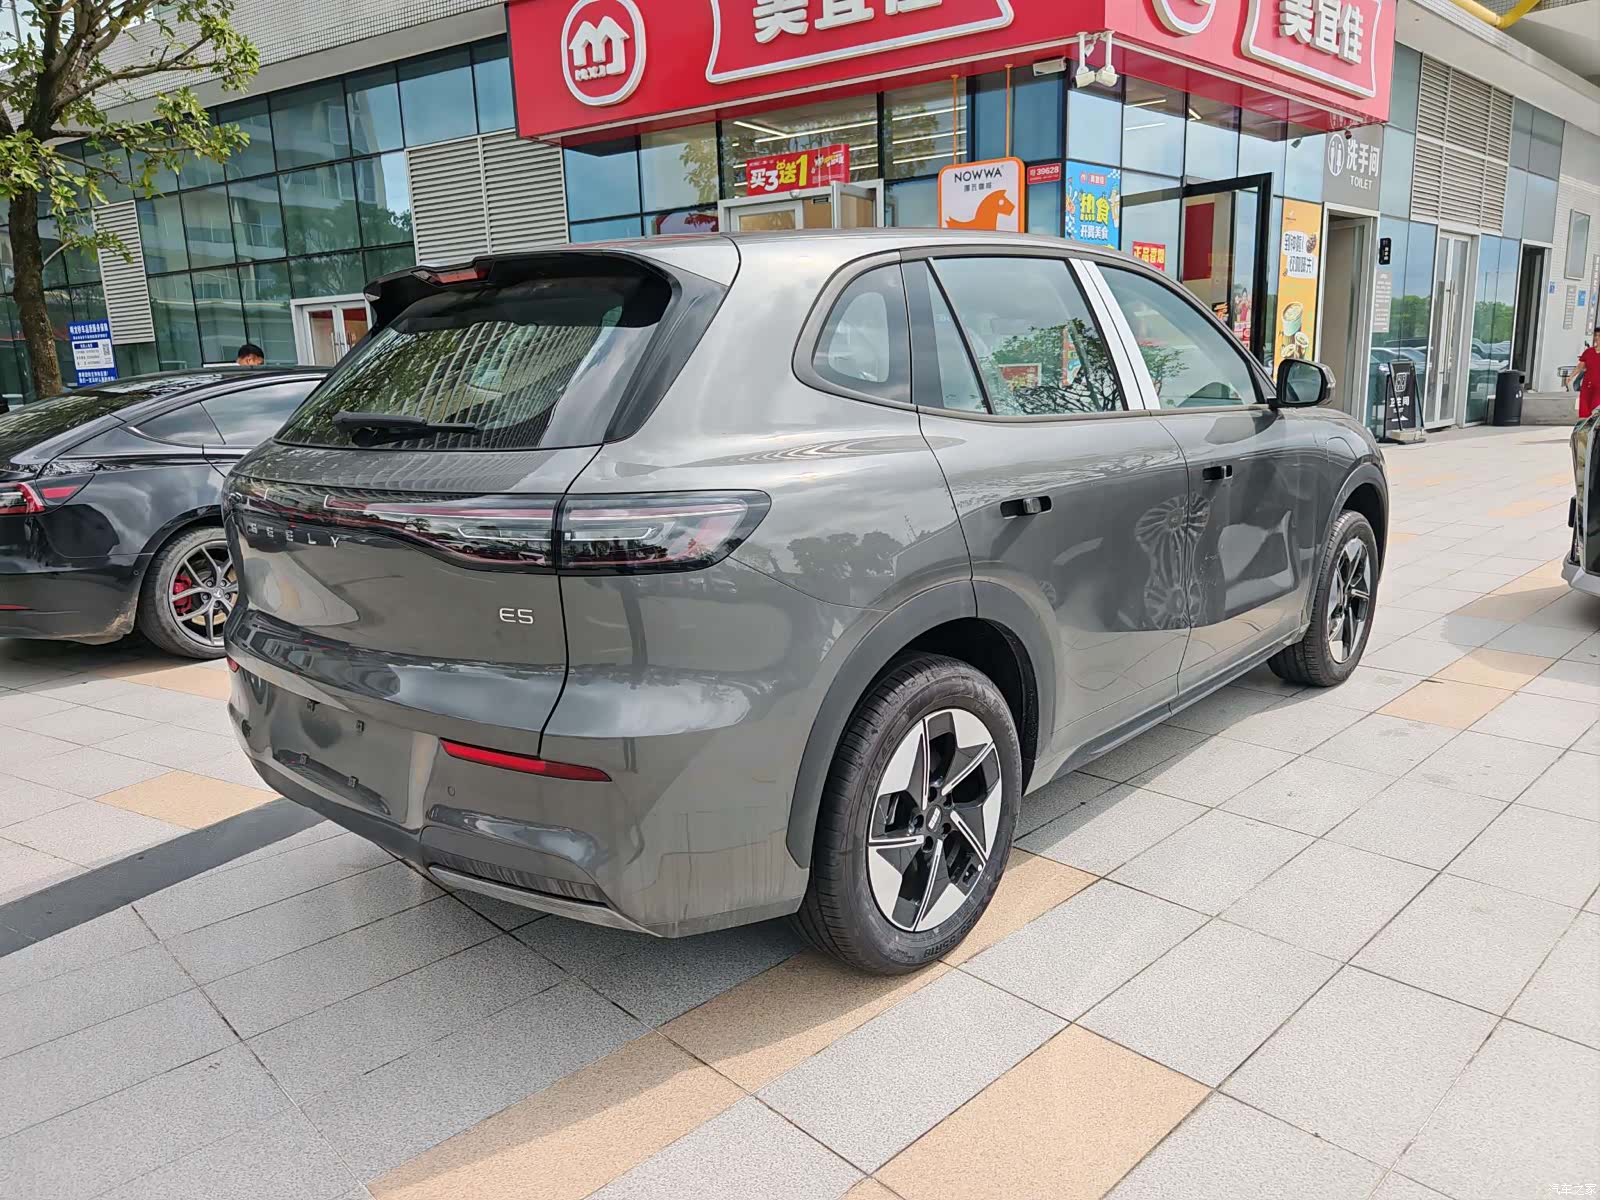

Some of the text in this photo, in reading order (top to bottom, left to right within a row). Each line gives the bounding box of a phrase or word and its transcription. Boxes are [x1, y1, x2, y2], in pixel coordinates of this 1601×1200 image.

[1279, 0, 1363, 64] 美宜佳
[1346, 139, 1380, 177] 洗手间
[954, 167, 1002, 183] NOWWA
[1350, 175, 1373, 190] TOILET
[1080, 193, 1110, 225] 热食
[245, 522, 341, 549] GEELY
[499, 607, 534, 625] E5
